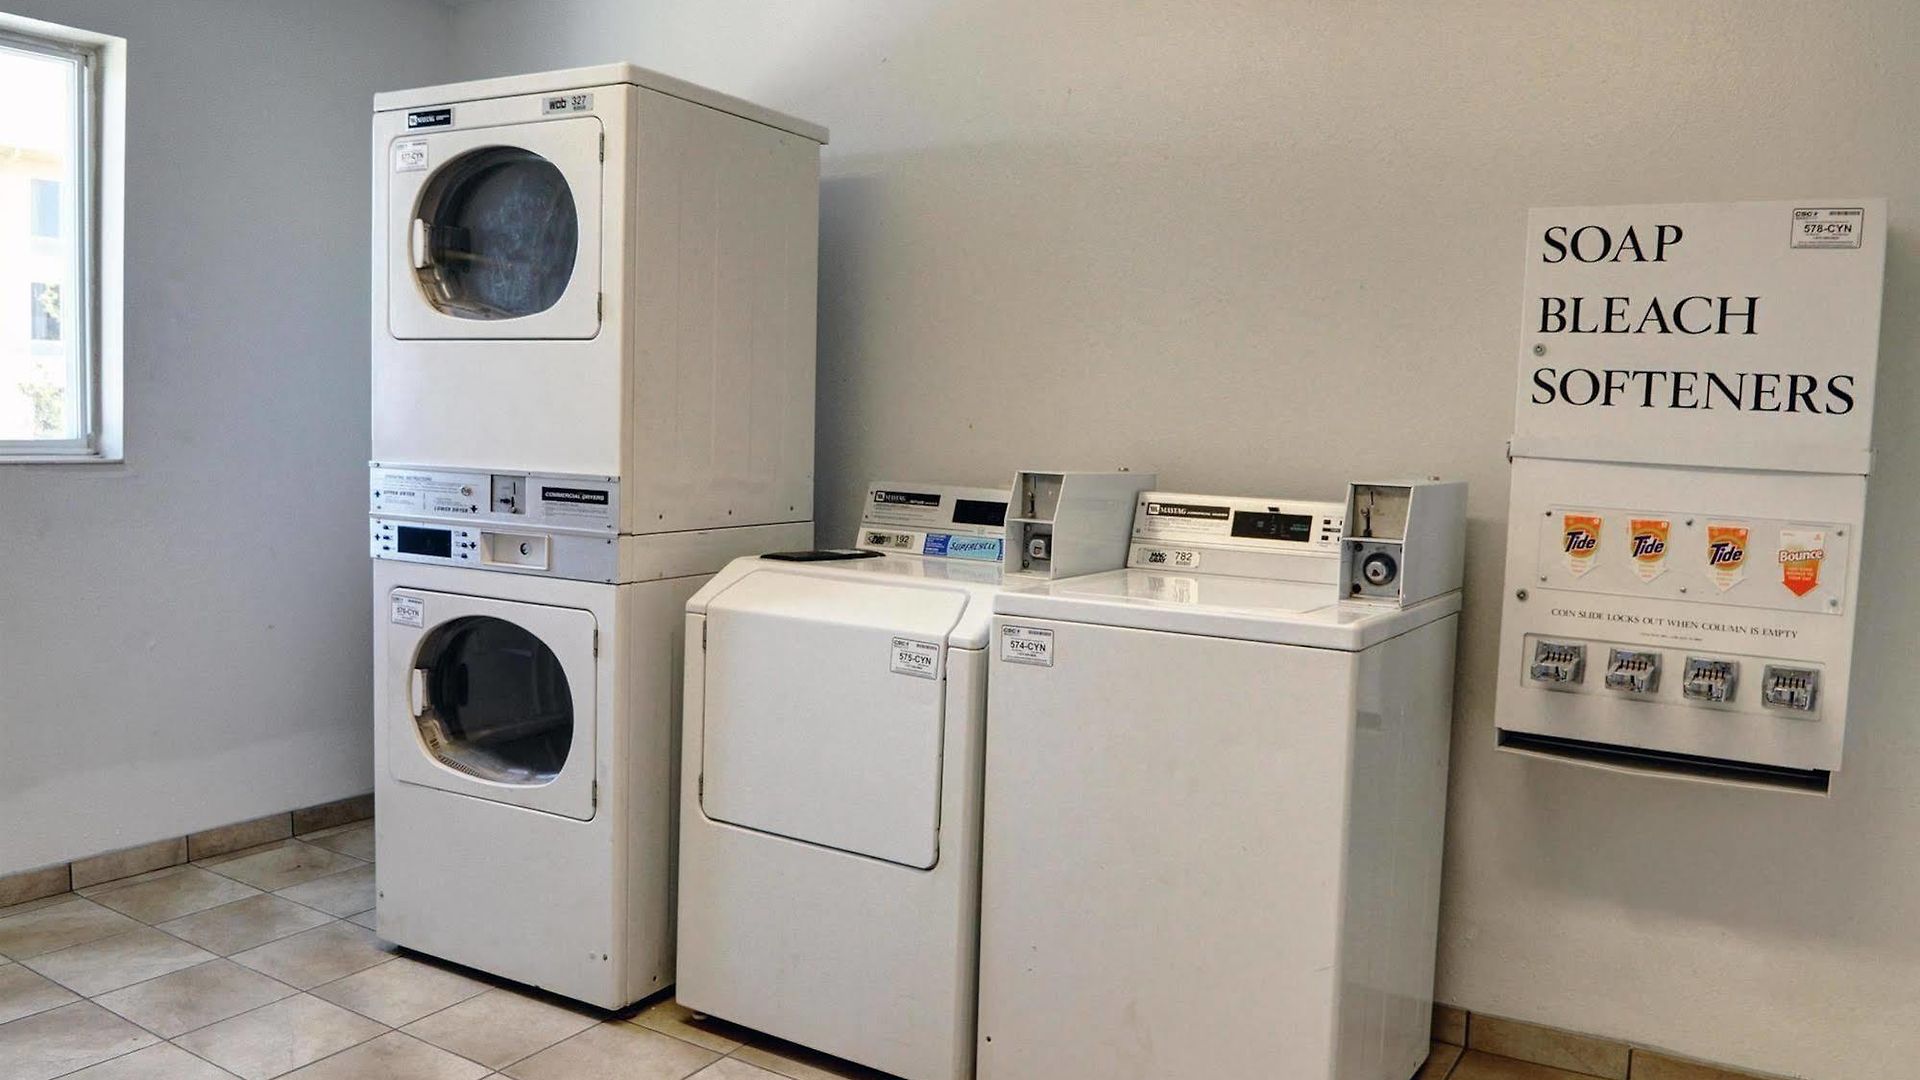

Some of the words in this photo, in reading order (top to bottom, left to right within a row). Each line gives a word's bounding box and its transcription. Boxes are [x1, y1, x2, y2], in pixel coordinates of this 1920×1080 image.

[572, 94, 586, 105] 327
[1804, 224, 1852, 233] 578-CYN
[1542, 224, 1683, 263] SOAP
[1537, 296, 1761, 335] BLEACH
[1531, 367, 1855, 415] SOFTENERS
[545, 491, 580, 499] COMMERCIAL
[1160, 507, 1187, 515] MAYTAG
[896, 535, 910, 543] 192
[1565, 531, 1596, 552] Tide
[1632, 535, 1664, 557] Tide
[1175, 551, 1192, 561] 782
[1710, 543, 1743, 565] Tide
[1779, 549, 1824, 563] Bounce
[1551, 608, 1576, 617] COIN
[1578, 610, 1603, 620] SLIDE
[1607, 613, 1640, 623] LOCKS
[1642, 616, 1664, 625] OUT
[1666, 619, 1698, 629] WHEN
[1701, 623, 1746, 633] COLUMN
[1750, 627, 1759, 635] IS
[1762, 628, 1798, 639] EMPTY
[1010, 640, 1046, 651] 574-CYN
[899, 652, 932, 665] 575-CYN
